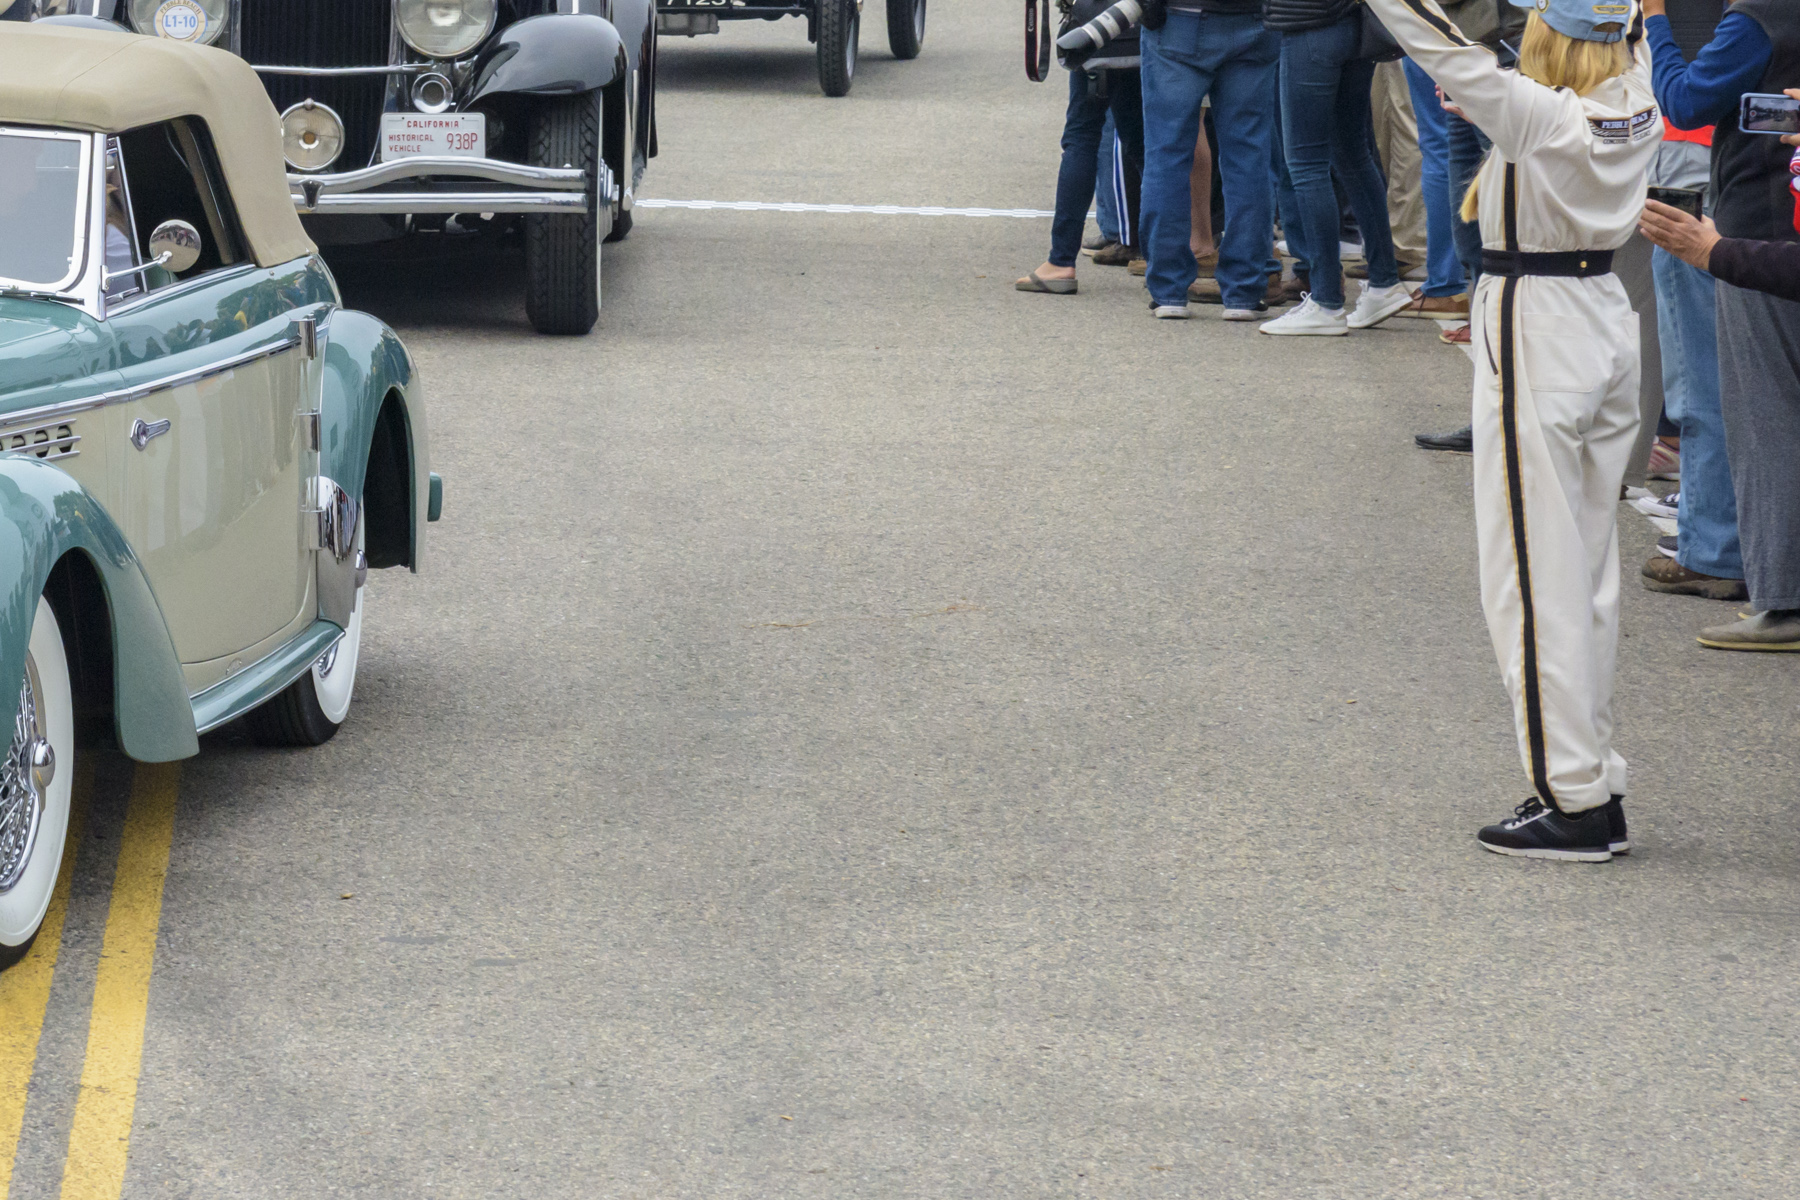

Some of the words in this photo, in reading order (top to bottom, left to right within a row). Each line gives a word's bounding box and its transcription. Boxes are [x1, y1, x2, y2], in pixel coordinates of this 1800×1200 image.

[160, 0, 181, 14] PEBBLE
[182, 0, 202, 15] BEACH
[165, 15, 196, 29] L1-10
[1027, 7, 1035, 33] Canon
[406, 120, 460, 129] CALIFORNIA
[388, 134, 435, 142] HISTORICAL
[446, 132, 478, 151] 938P
[388, 145, 422, 153] VEHICLE
